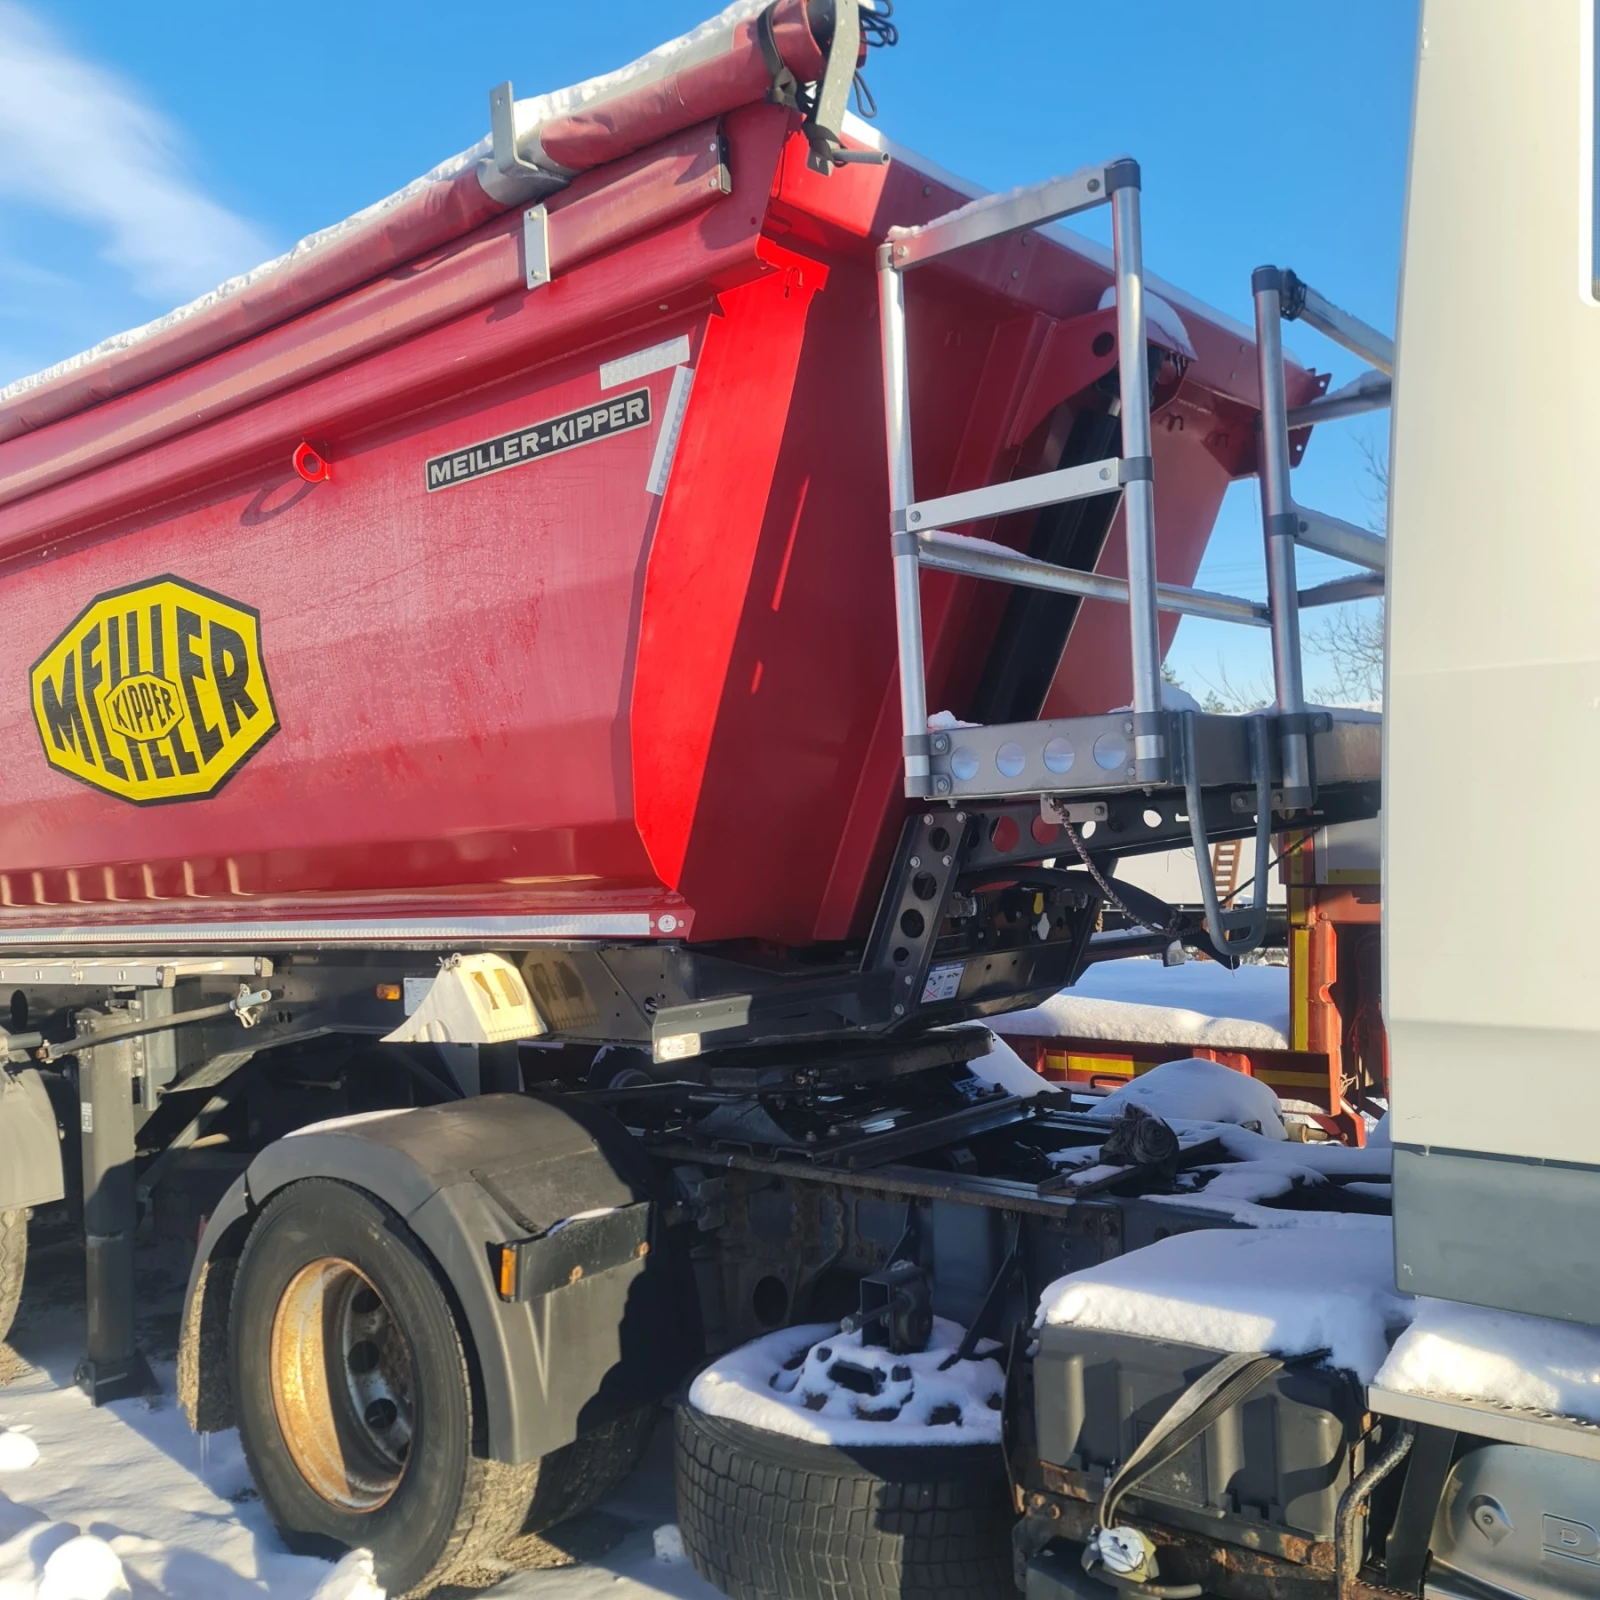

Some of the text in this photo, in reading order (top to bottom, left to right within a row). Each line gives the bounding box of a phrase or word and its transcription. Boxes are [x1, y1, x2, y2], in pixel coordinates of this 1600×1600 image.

[430, 397, 645, 485] MEILLER-KIPPER
[41, 603, 259, 783] MEILLER
[112, 682, 175, 734] KIPPER
